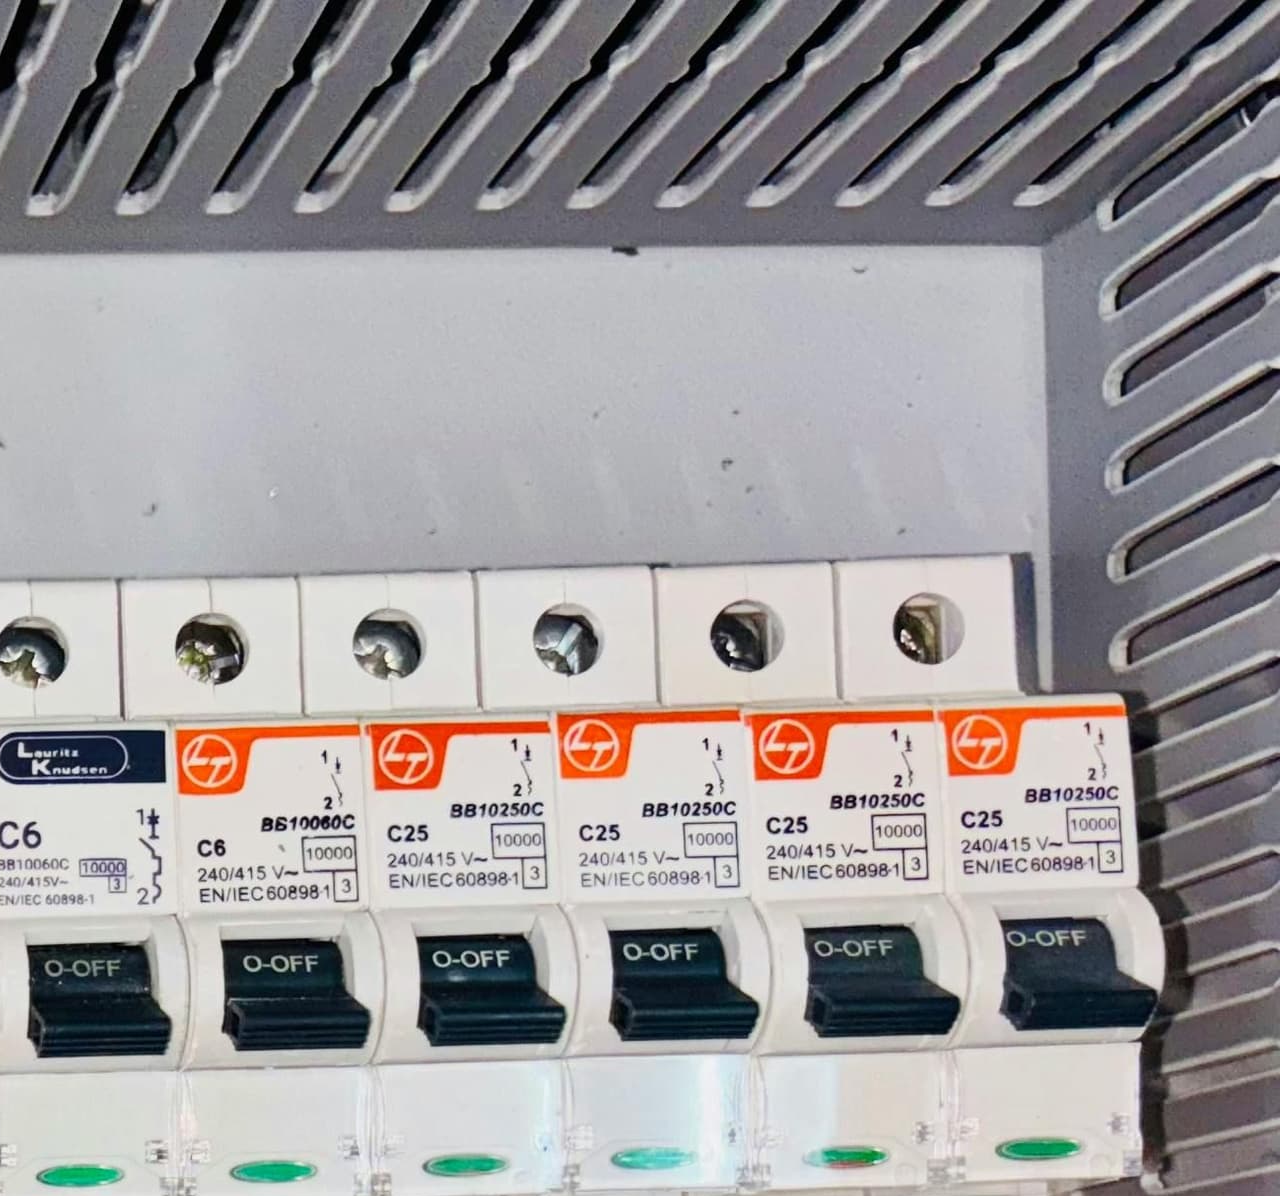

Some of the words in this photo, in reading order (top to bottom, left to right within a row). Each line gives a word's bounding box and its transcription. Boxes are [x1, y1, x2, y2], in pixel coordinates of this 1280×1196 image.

[511, 739, 517, 752] 1
[321, 751, 327, 764] 1
[32, 759, 107, 775] Knudsen
[514, 784, 522, 796] 2
[1025, 786, 1118, 803] BB10250C
[324, 797, 332, 810] 2
[642, 801, 736, 817] BB10250C
[830, 793, 925, 809] BB10250C
[451, 802, 544, 818] BB10250C
[766, 816, 808, 834] C25
[961, 810, 1003, 828] C25
[1071, 818, 1116, 831] 10000
[388, 825, 428, 842] C25
[579, 824, 620, 841] C25
[688, 833, 733, 846] 10000
[877, 825, 922, 838] 10000
[197, 839, 226, 857] C6
[496, 834, 541, 847] 10000
[307, 847, 352, 860] 10000
[530, 866, 539, 880] 3
[768, 864, 832, 880] EN/IEC
[963, 858, 1028, 874] EN/IEC
[341, 879, 350, 893] 3
[389, 872, 453, 888] EN/IEC
[581, 872, 644, 887] EN/IEC
[200, 887, 263, 903] EN/IEC
